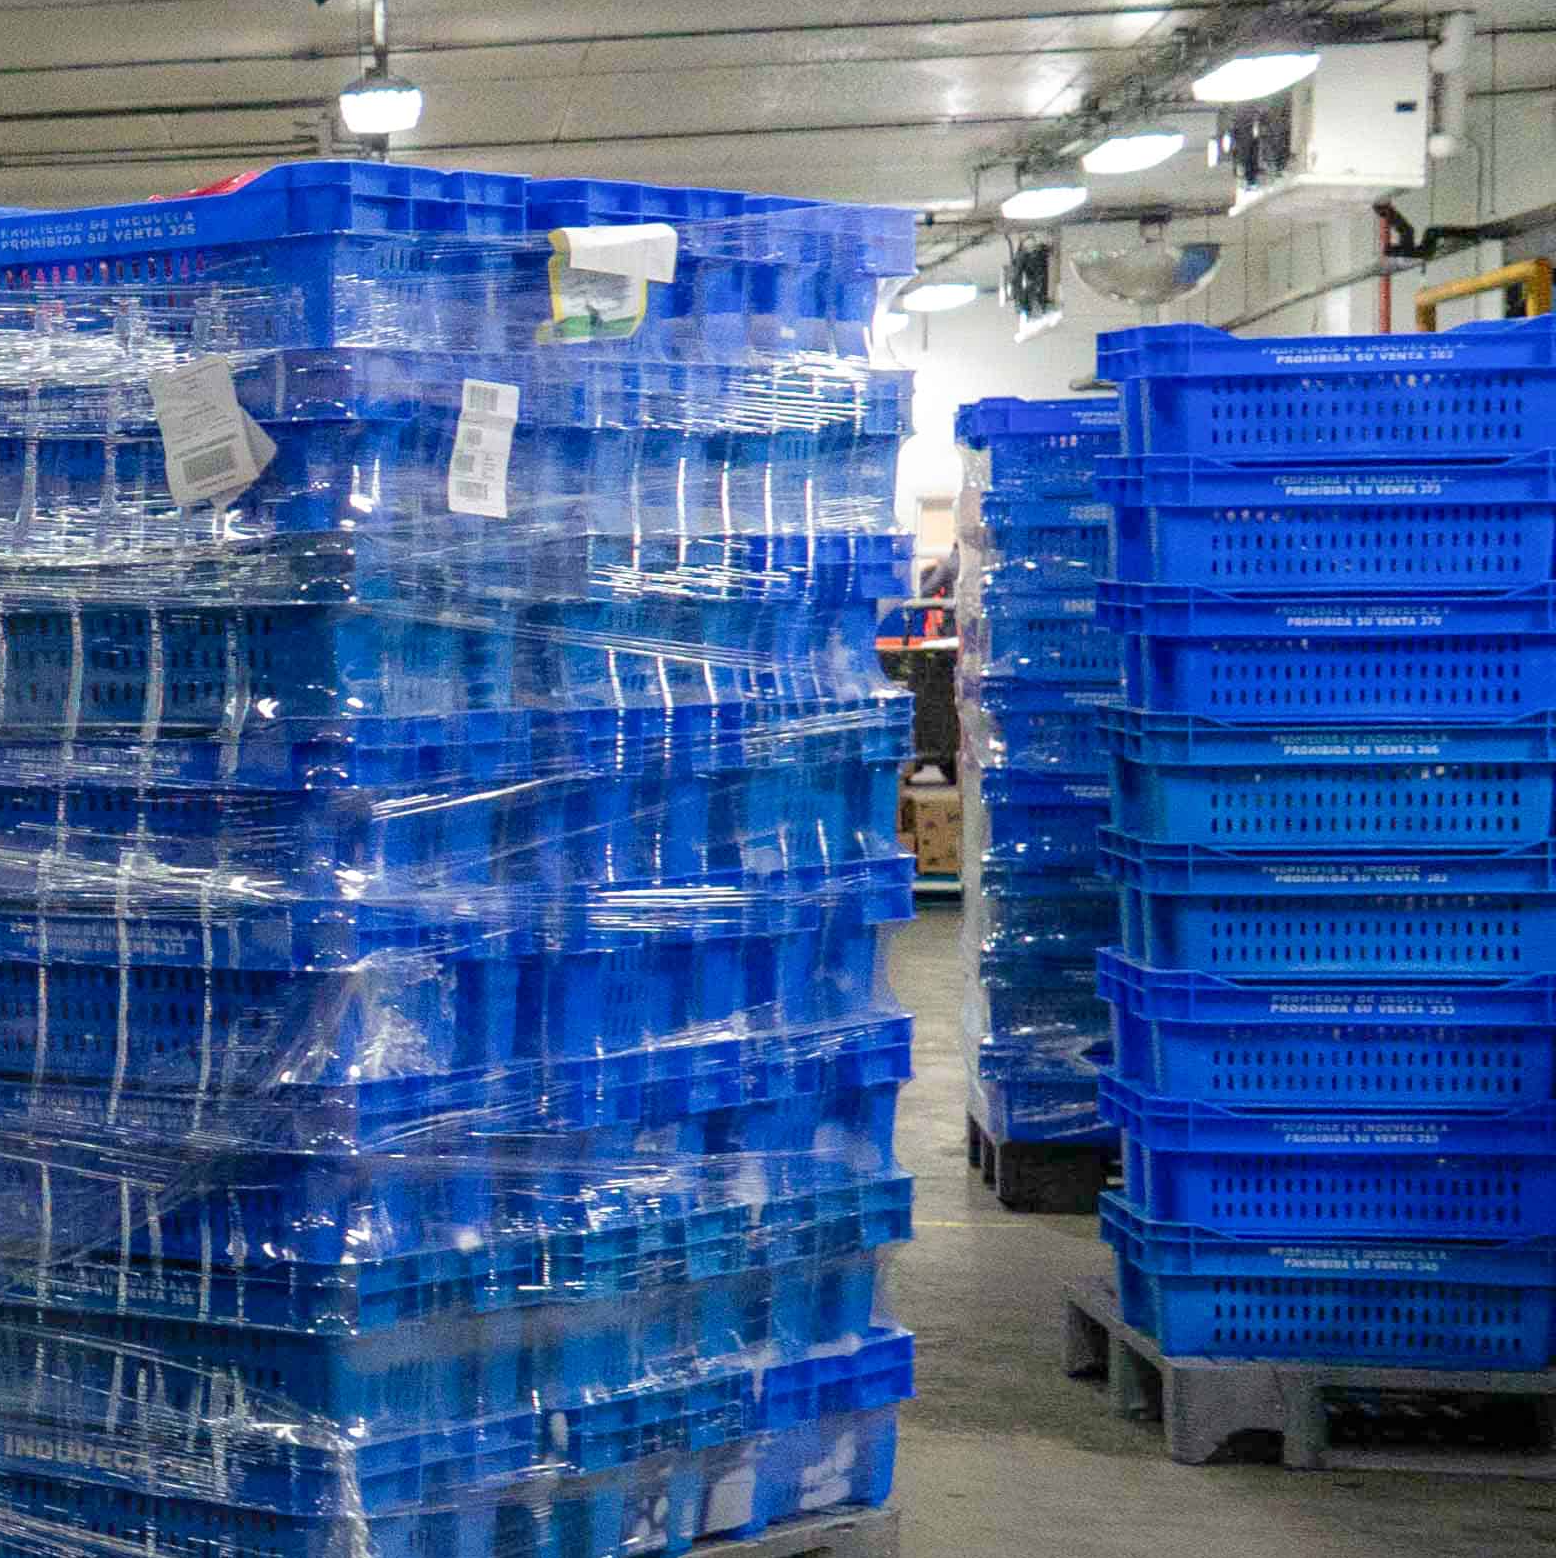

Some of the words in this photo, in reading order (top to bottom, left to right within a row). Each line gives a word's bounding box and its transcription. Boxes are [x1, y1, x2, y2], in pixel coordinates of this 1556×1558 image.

[0, 234, 82, 250] PROHIBIDA
[87, 231, 108, 244] SU
[114, 228, 164, 242] VENTA
